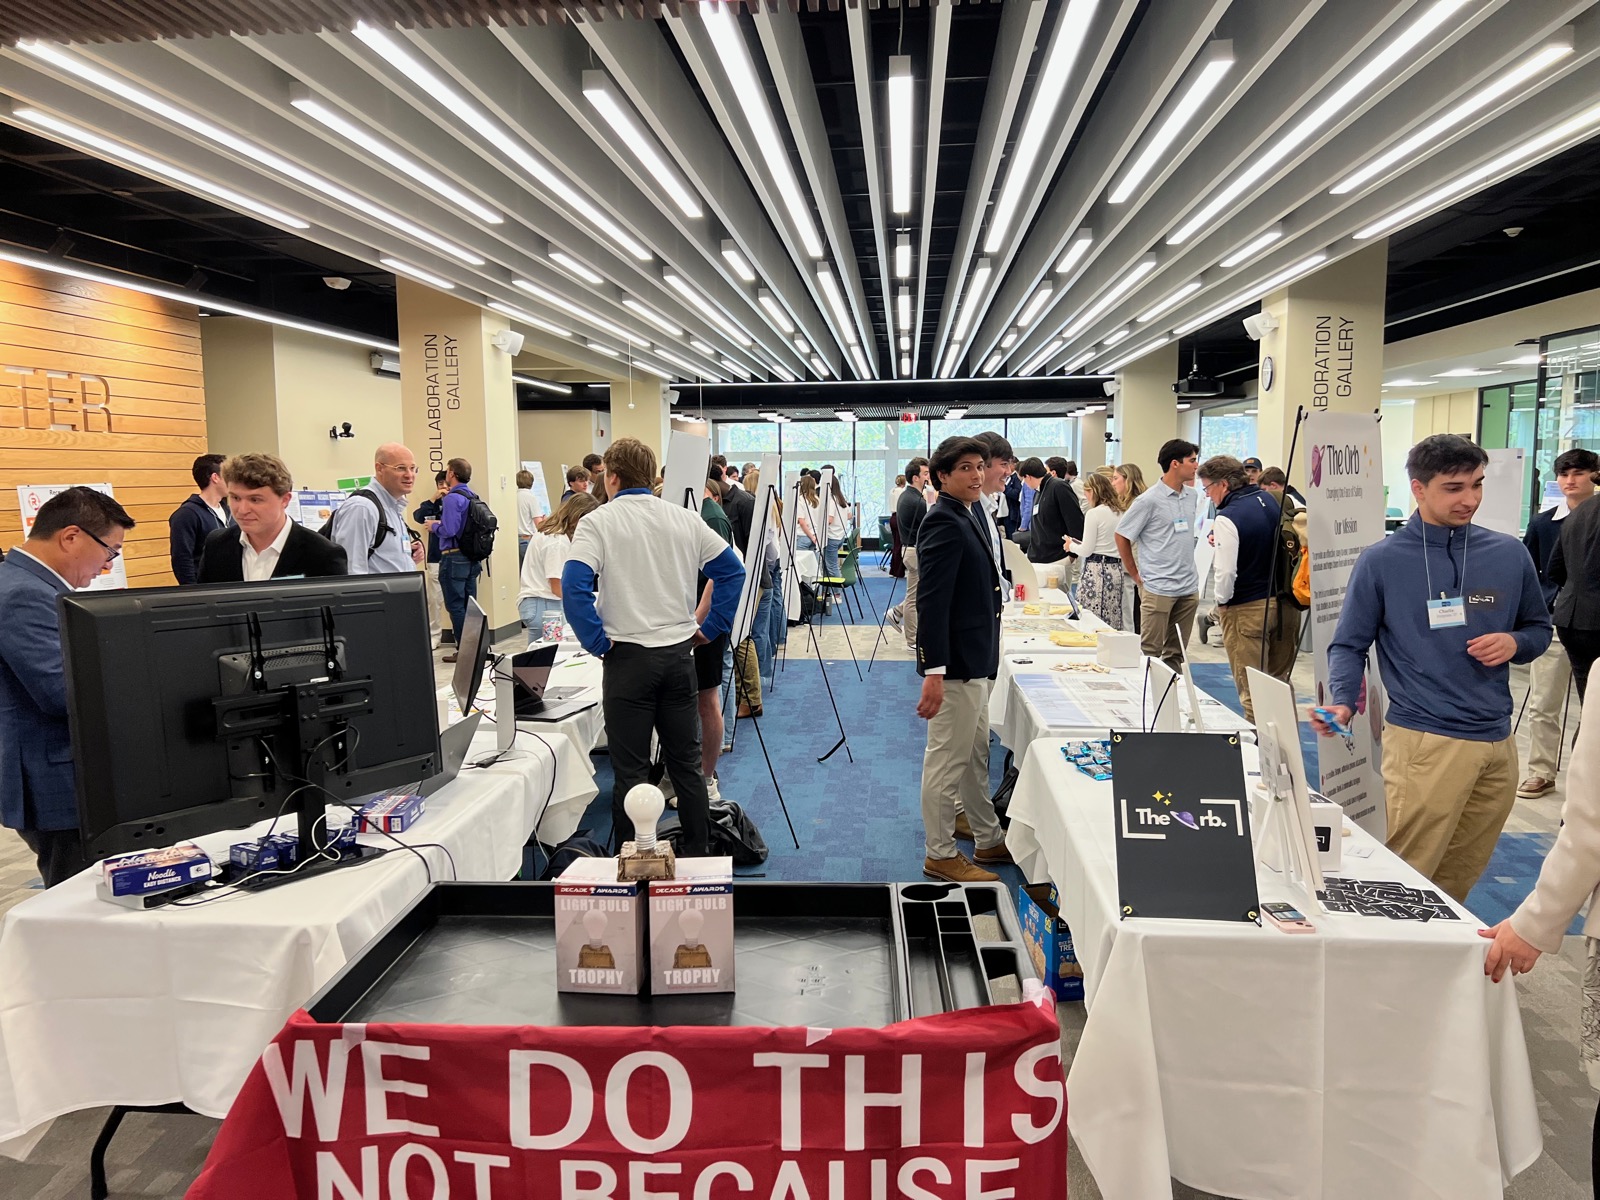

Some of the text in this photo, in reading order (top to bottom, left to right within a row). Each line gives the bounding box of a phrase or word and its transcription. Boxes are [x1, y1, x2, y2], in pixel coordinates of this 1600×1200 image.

[444, 335, 460, 410] GALLERY
[1313, 316, 1331, 412] BORATION
[1336, 316, 1354, 397] GALLERY
[4, 366, 112, 434] TER
[424, 334, 443, 473] COLLABORATION
[1327, 444, 1360, 475] The Orb
[1135, 807, 1171, 826] The
[147, 869, 176, 881] Noodle
[560, 898, 630, 912] LIGHT BULB
[655, 897, 727, 912] LIGHT BULB
[568, 969, 624, 985] TROPHY
[664, 969, 720, 985] TROPHY
[262, 1039, 1064, 1154] WE DO THIS
[316, 1143, 510, 1200] NOT
